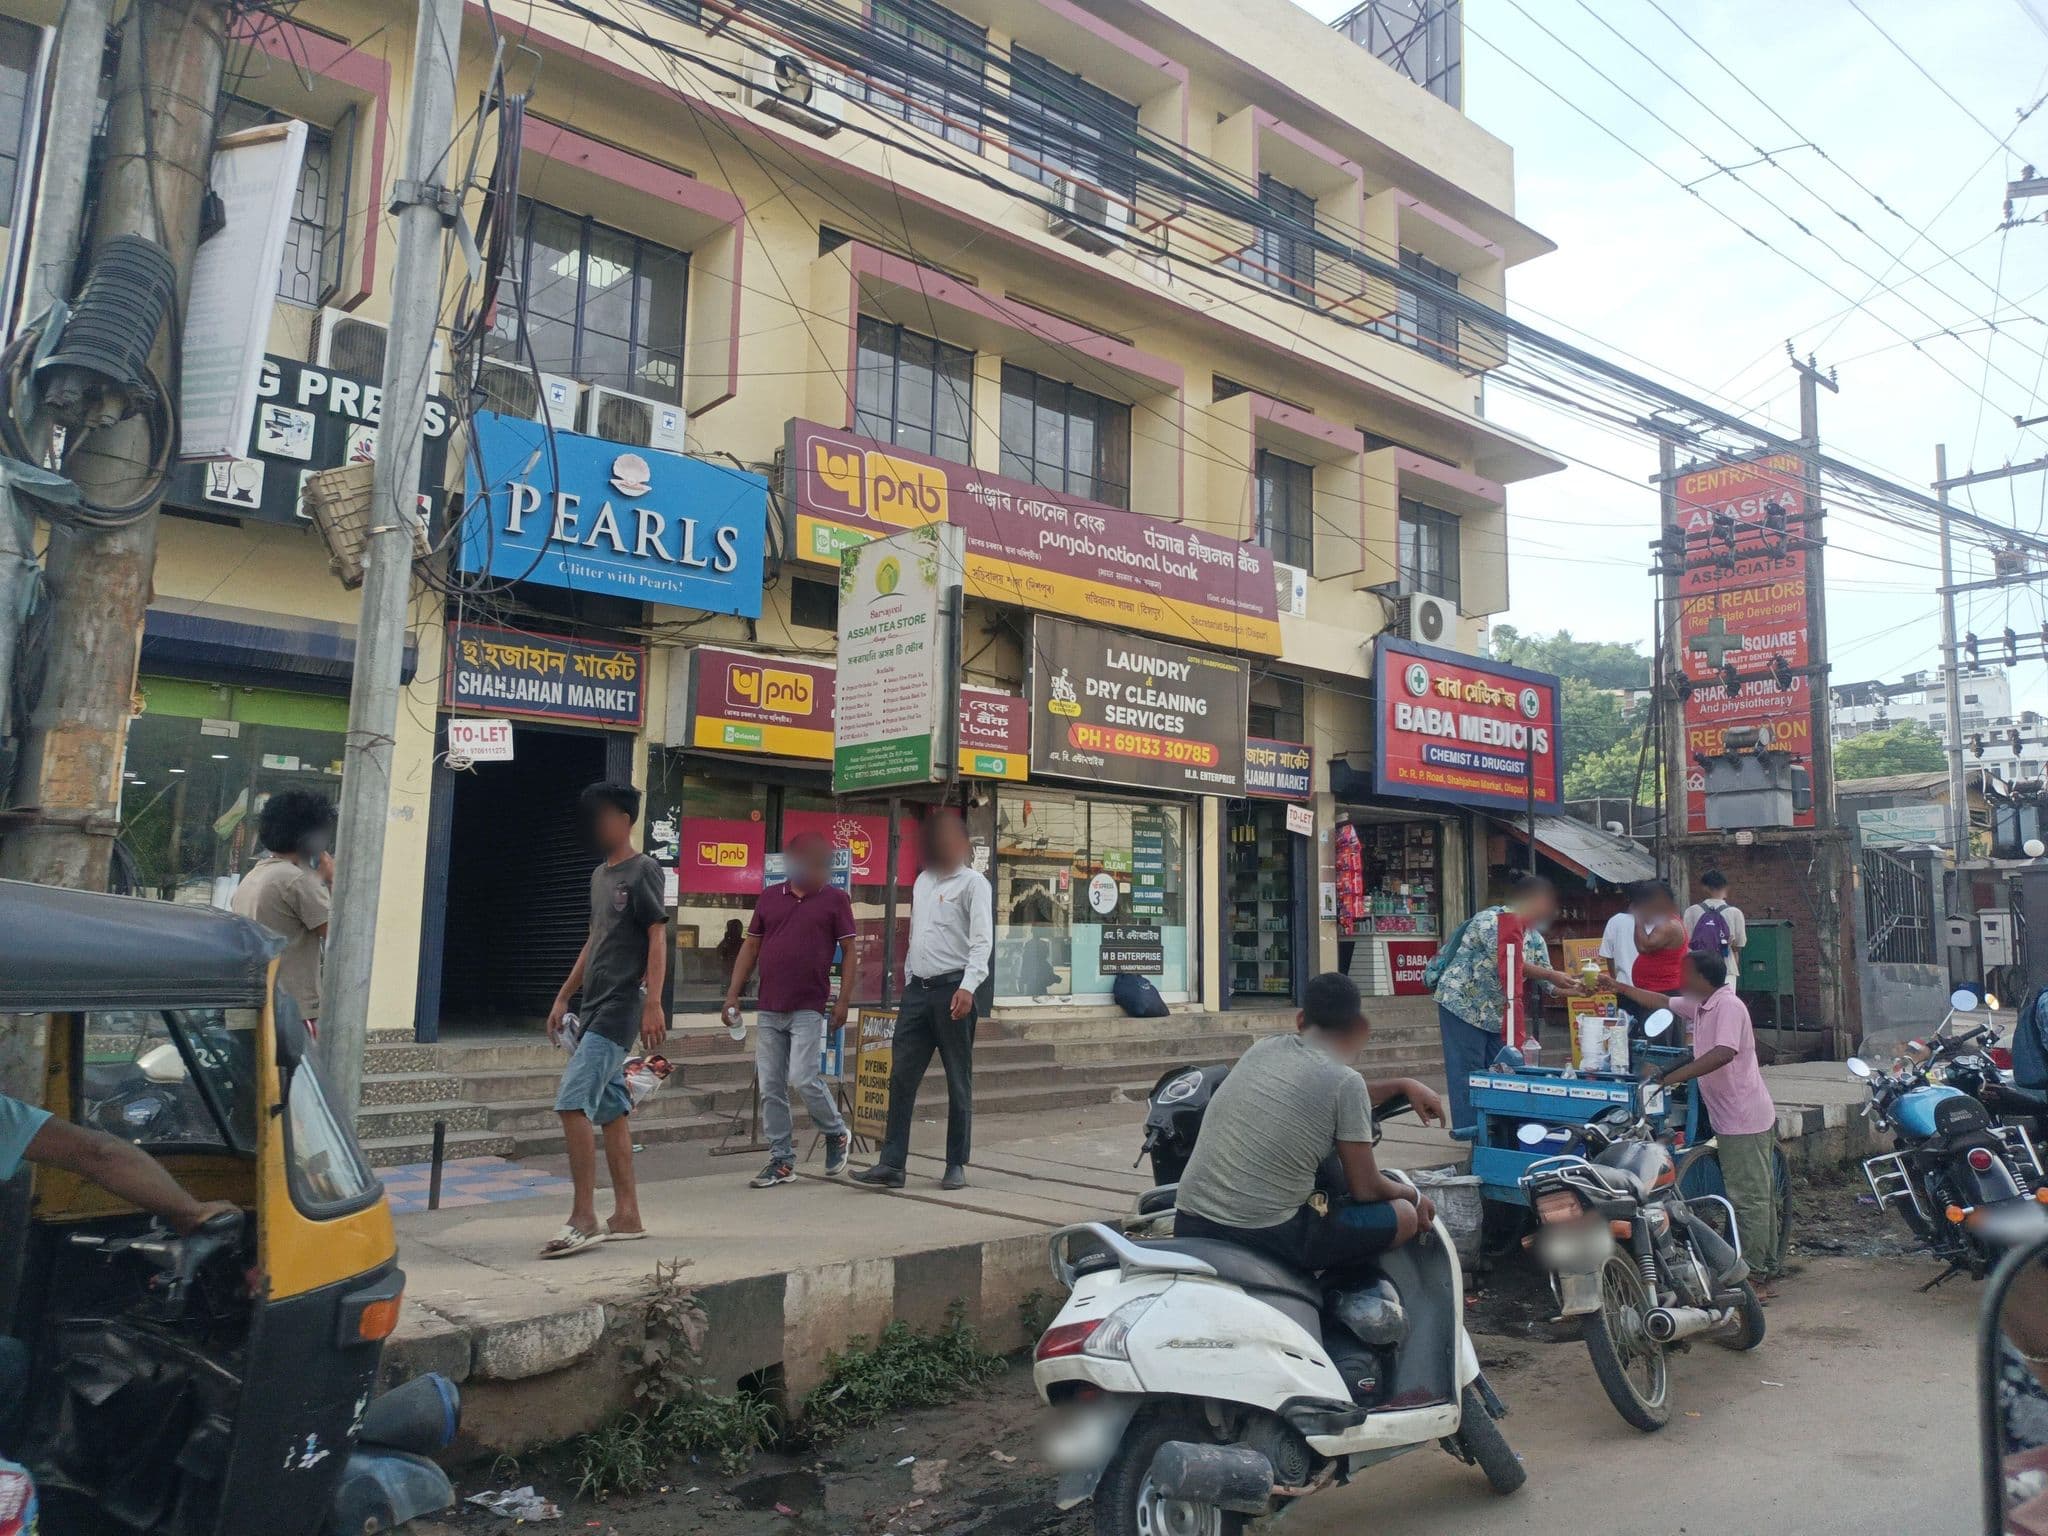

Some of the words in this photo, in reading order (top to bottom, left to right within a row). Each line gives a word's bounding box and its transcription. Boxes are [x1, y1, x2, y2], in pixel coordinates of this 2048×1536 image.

[297, 368, 446, 437] PRES
[1685, 465, 1758, 495] CENTRAL
[873, 472, 941, 514] pnb
[503, 480, 738, 573] PEARLS
[1073, 511, 1106, 536] বেংক
[1039, 530, 1096, 557] punjab
[1097, 544, 1161, 573] national
[1162, 553, 1199, 581] bank
[1691, 556, 1797, 585] ASSOCIATES
[607, 571, 636, 585] with
[639, 575, 683, 593] Pearls!
[1720, 580, 1806, 608] REALTORS
[1747, 599, 1801, 618] Developer)
[847, 624, 877, 640] ASSAM
[878, 620, 896, 634] TEA
[896, 613, 927, 630] STORE
[1744, 631, 1797, 652] SQUARE
[1106, 648, 1191, 682] LAUNDRY
[457, 671, 563, 705] SHAHJAHAN
[567, 684, 637, 713] MARKET
[765, 678, 809, 705] pnb
[1145, 676, 1153, 687] &
[1434, 677, 1461, 700] বাবা
[1086, 677, 1121, 700] DRY
[1125, 685, 1207, 716] CLEANING
[1694, 682, 1744, 704] SHARA
[1700, 701, 1720, 714] And
[1721, 694, 1793, 713] physiotherapy
[1105, 704, 1185, 734] SERVICES
[1395, 702, 1458, 739] BABA
[453, 726, 508, 743] TO-LET
[969, 724, 1009, 738] bank
[1078, 727, 1101, 747] PH
[1114, 733, 1161, 756] 69133
[1164, 741, 1211, 764] 30785
[1430, 747, 1472, 766] CHEMIST
[1472, 754, 1480, 768] &
[1481, 756, 1526, 774] DRUGGIST
[1200, 771, 1236, 785] ENTERPRISE
[1277, 775, 1309, 791] MARKET
[1399, 767, 1409, 777] Dr.
[1289, 809, 1312, 824] TO-LET
[720, 848, 745, 863] pnb
[1104, 860, 1127, 871] CLEAN
[1093, 890, 1101, 906] 3
[1102, 951, 1109, 960] M
[1110, 951, 1116, 960] B
[1117, 951, 1161, 961] ENTERPRISE
[1406, 955, 1428, 966] BABA
[1396, 970, 1425, 982] MEDIC
